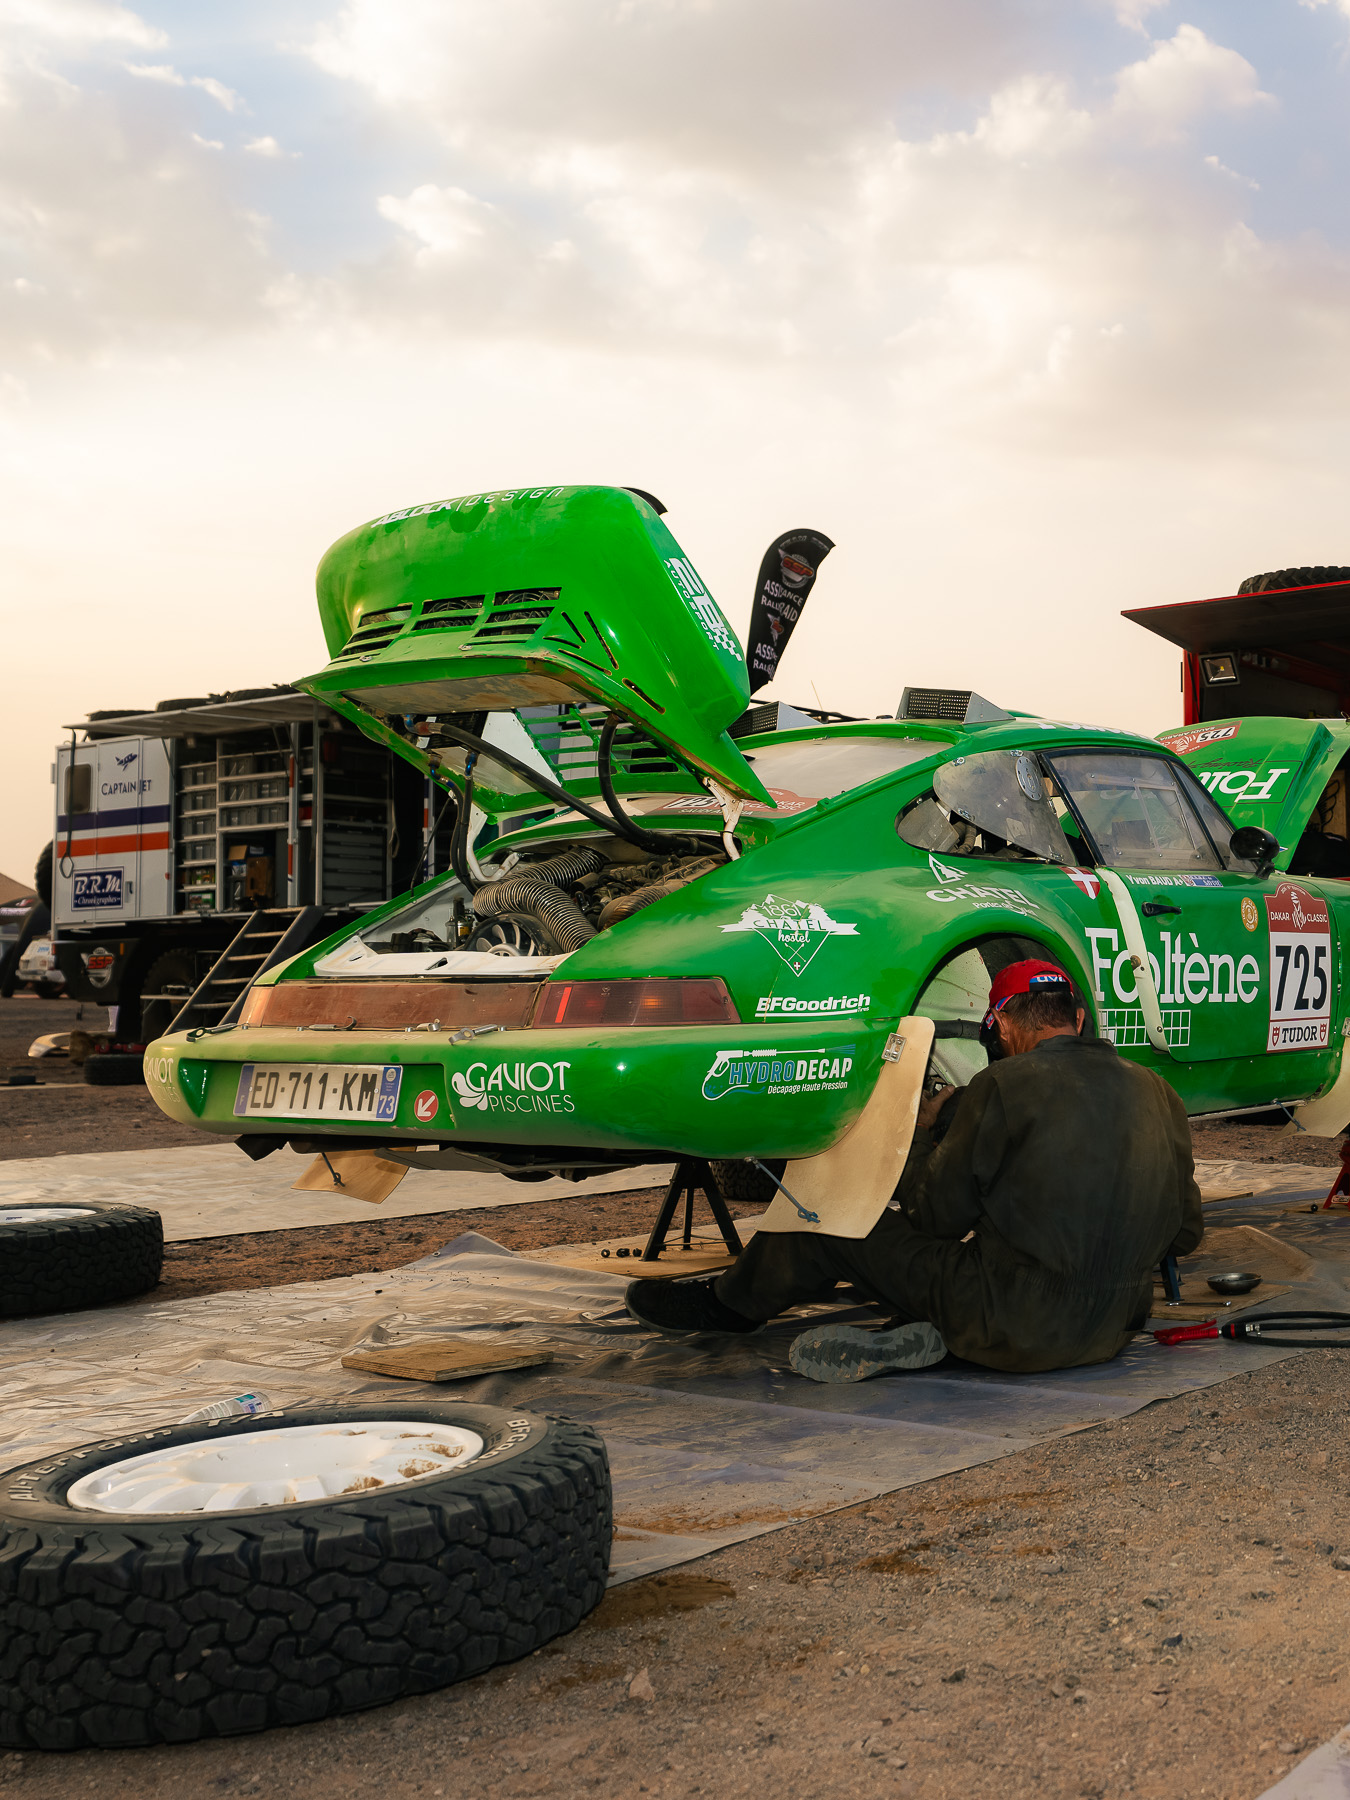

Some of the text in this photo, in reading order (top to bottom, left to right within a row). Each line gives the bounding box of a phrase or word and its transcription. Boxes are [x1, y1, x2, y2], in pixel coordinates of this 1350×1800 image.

[663, 559, 720, 651] AUTOSPORT
[1199, 726, 1234, 741] 725
[101, 781, 137, 796] CAPTAIN
[1125, 874, 1150, 885] Yvon
[1148, 876, 1174, 886] BAUD
[926, 883, 1041, 910] CHÂTEL
[761, 902, 803, 917] 1861
[1270, 911, 1328, 923] DAKAR CLASSIC
[778, 929, 811, 943] hostel
[1274, 944, 1328, 1012] 725
[756, 993, 871, 1012] BFGoodrich
[1281, 1025, 1318, 1044] TUDOR
[464, 1061, 572, 1093] GAVIOT
[729, 1057, 853, 1085] HYDRODECAP
[767, 1080, 848, 1095] Décapage Haute Pression
[379, 1094, 396, 1115] 73
[490, 1094, 576, 1113] PISCINES
[8, 1428, 173, 1502] All-Terrain
